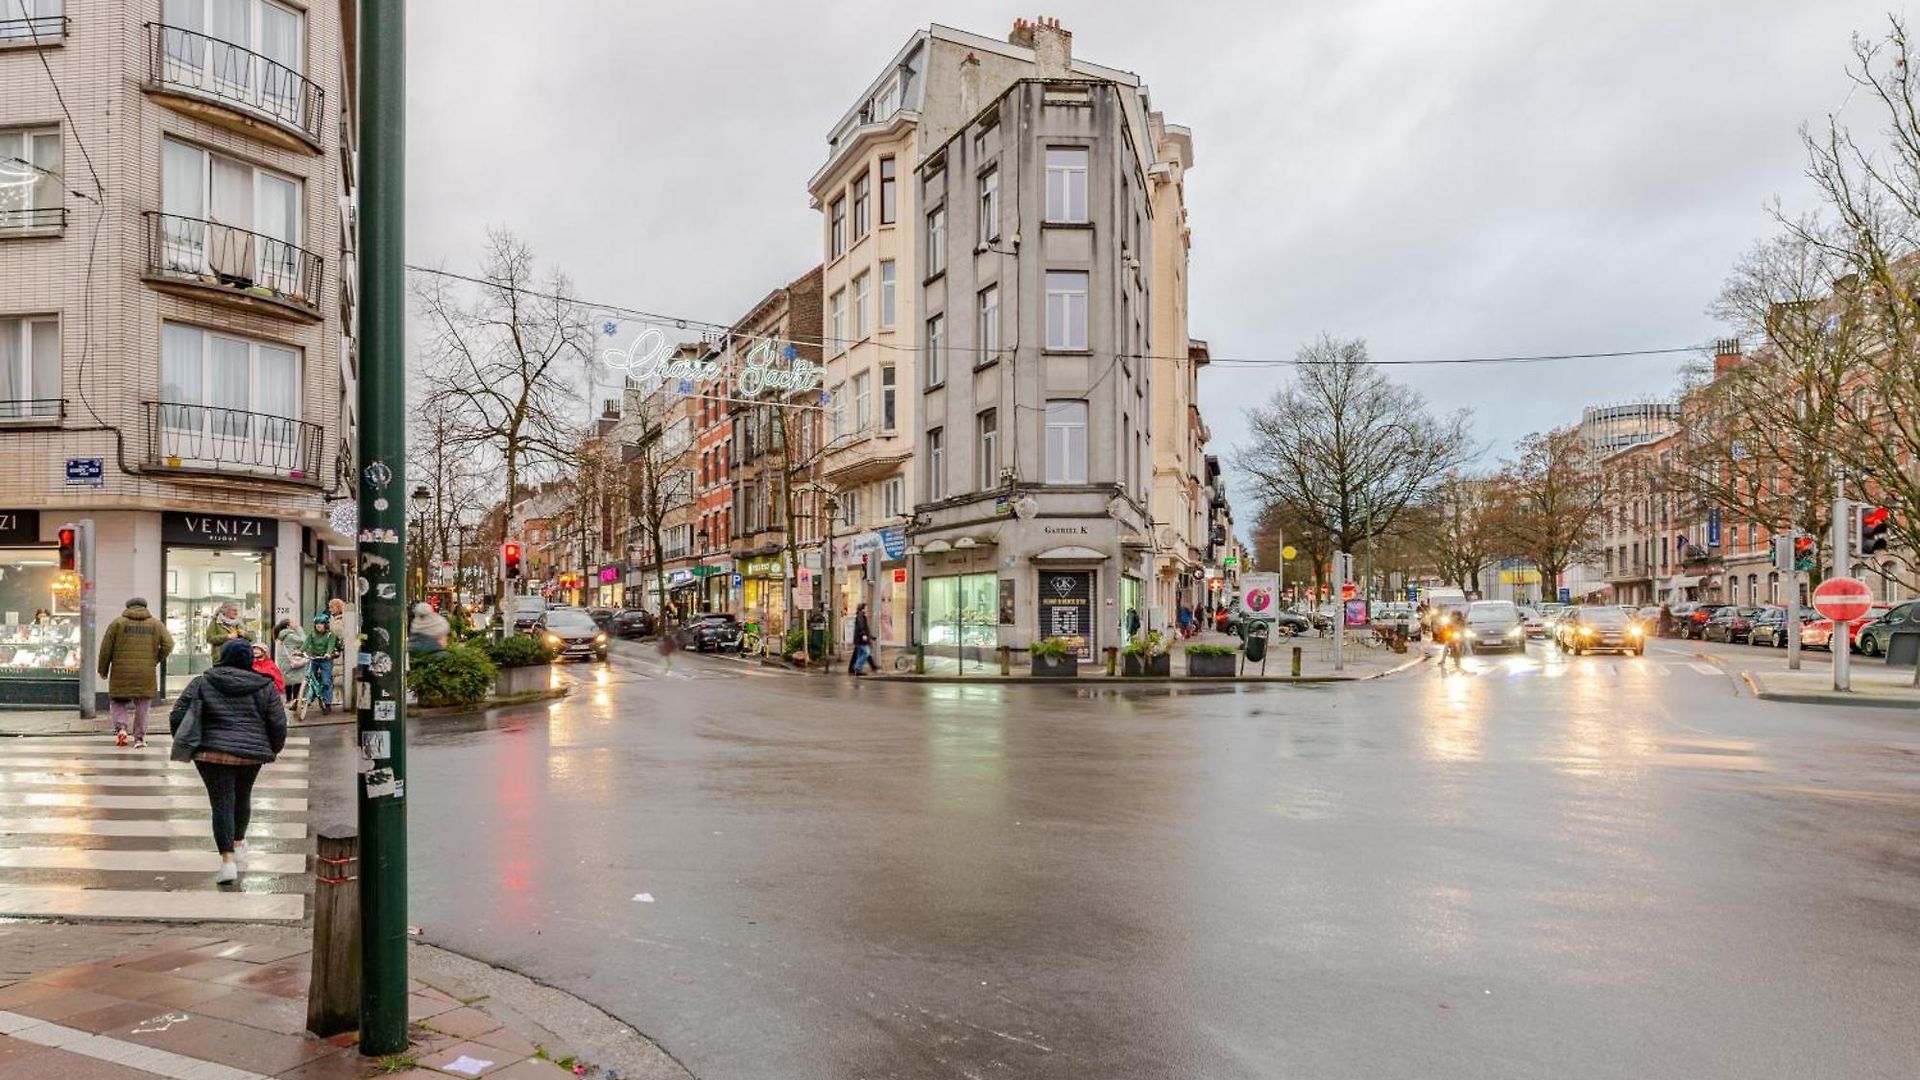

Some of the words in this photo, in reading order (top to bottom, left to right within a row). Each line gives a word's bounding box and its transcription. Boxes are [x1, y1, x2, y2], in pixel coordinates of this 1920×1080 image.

[602, 328, 720, 382] Chasse
[184, 516, 262, 536] VENIZI
[1081, 526, 1088, 535] K
[733, 574, 741, 586] P
